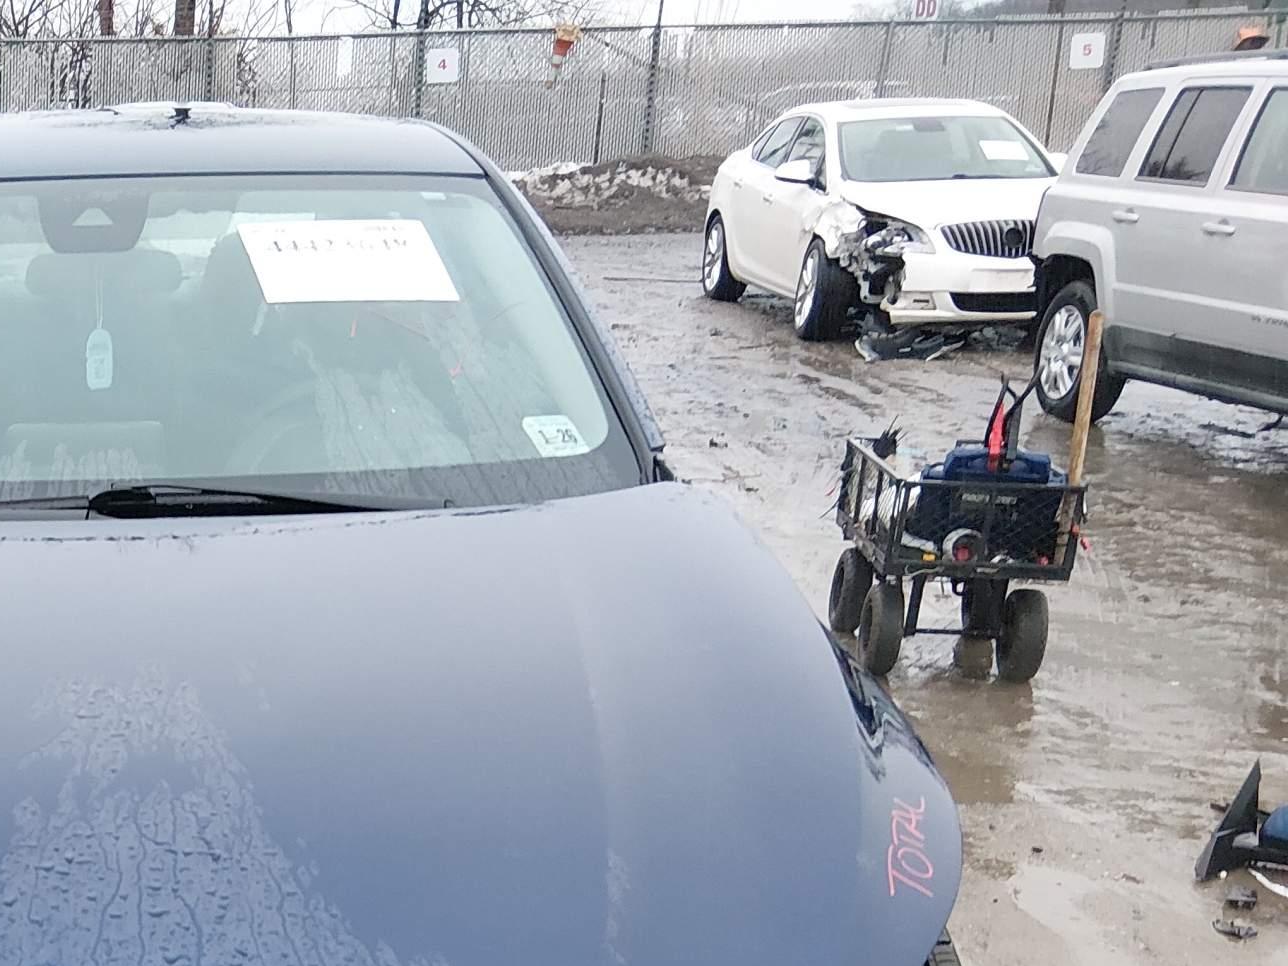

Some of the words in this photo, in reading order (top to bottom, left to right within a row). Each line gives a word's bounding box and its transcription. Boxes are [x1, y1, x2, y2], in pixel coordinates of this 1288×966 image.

[1083, 43, 1092, 56] 5
[438, 59, 447, 70] 4
[887, 795, 934, 897] TOTAL
